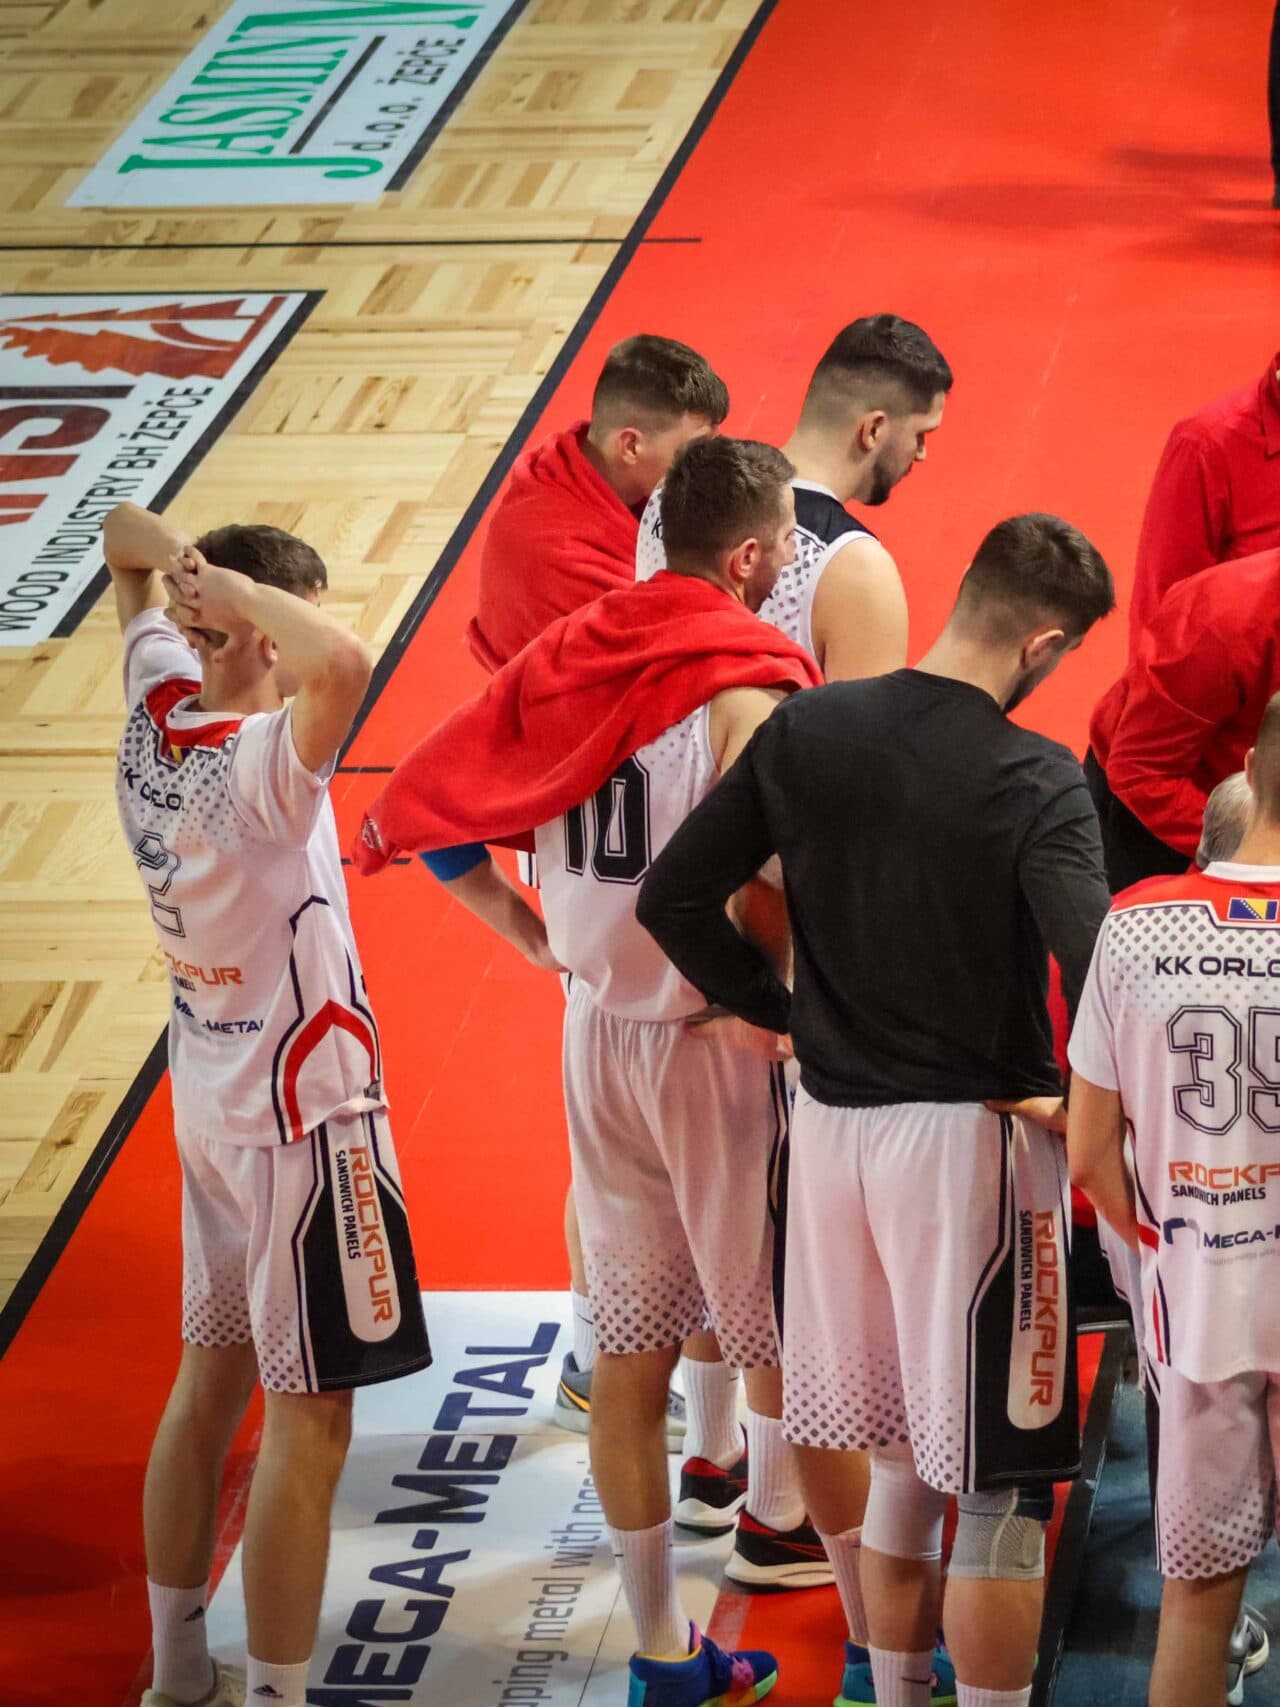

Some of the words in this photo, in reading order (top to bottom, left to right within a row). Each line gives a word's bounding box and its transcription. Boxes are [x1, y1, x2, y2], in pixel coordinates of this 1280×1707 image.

[375, 37, 466, 87] ŽEPČE
[334, 97, 422, 152] d.o.o.
[117, 386, 214, 441] ŽEPČE
[107, 446, 168, 469] BH
[32, 474, 144, 564] INDUSTRY
[0, 570, 69, 632] WOOD
[1154, 956, 1193, 976] KK
[335, 1149, 355, 1214] SANDWICH
[1222, 1187, 1266, 1206] PANELS
[344, 1215, 361, 1260] PANELS
[349, 1146, 394, 1325] ROCKPUR
[1019, 1209, 1033, 1280] SANDWICH
[1019, 1283, 1032, 1332] PANELS
[1029, 1210, 1059, 1407] ROCKPUR
[543, 1521, 604, 1569] with
[524, 1577, 585, 1640] metal
